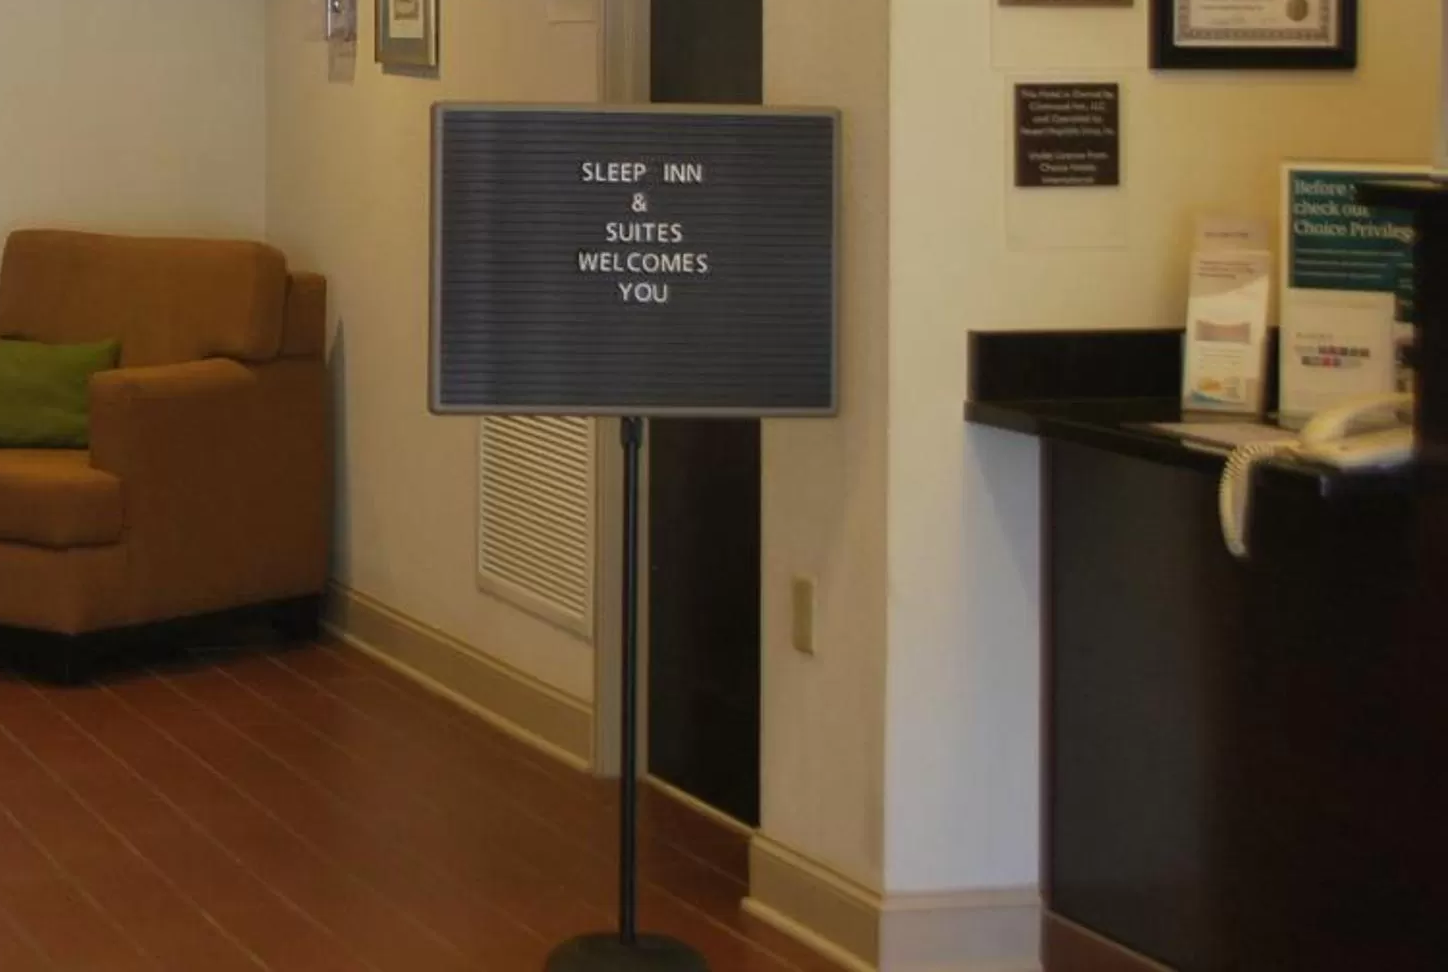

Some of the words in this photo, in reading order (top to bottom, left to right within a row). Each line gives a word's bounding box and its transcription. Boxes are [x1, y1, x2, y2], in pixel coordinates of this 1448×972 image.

[581, 162, 647, 183] SLEEP
[663, 162, 703, 183] INN
[1294, 179, 1347, 196] Before
[631, 192, 648, 213] &
[1294, 199, 1340, 216] check
[605, 222, 683, 243] SUITES
[1294, 219, 1348, 236] Choice
[1349, 220, 1416, 244] Privileg
[578, 252, 709, 274] WELCOMES
[618, 282, 669, 303] YOU
